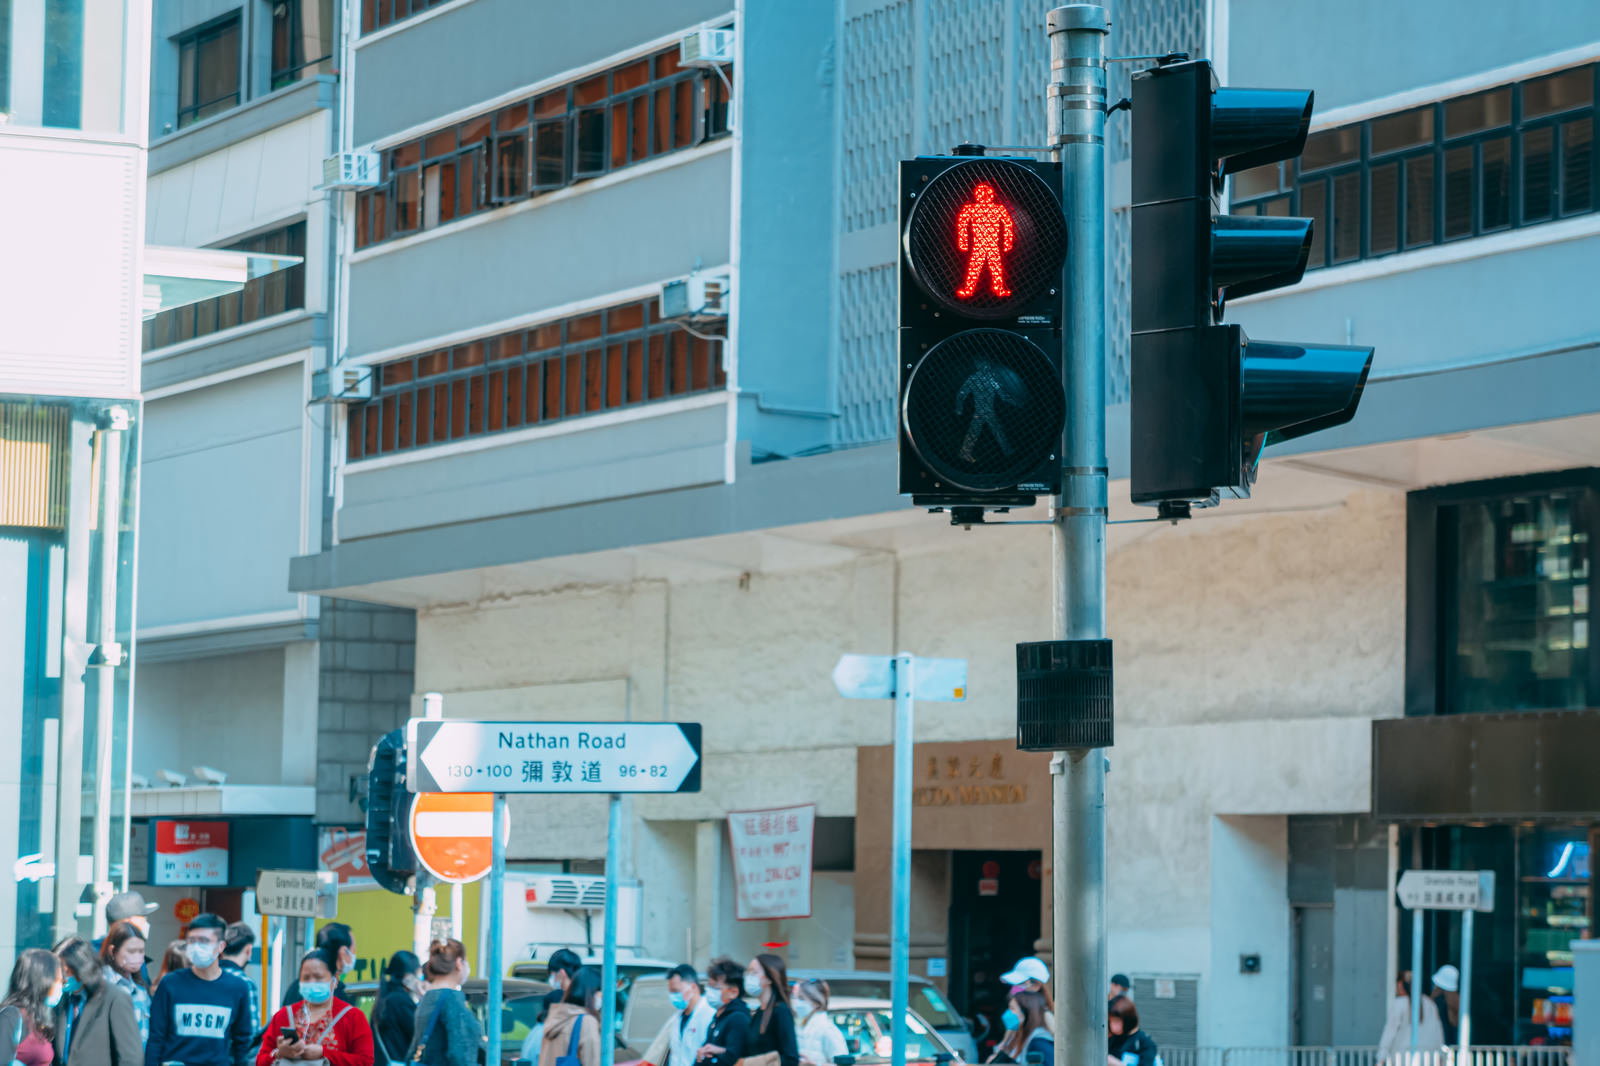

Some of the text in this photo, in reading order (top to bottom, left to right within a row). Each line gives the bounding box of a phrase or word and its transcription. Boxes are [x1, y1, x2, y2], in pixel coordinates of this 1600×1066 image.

[498, 731, 626, 749] Nathan Road
[521, 760, 602, 783] 彌敦道
